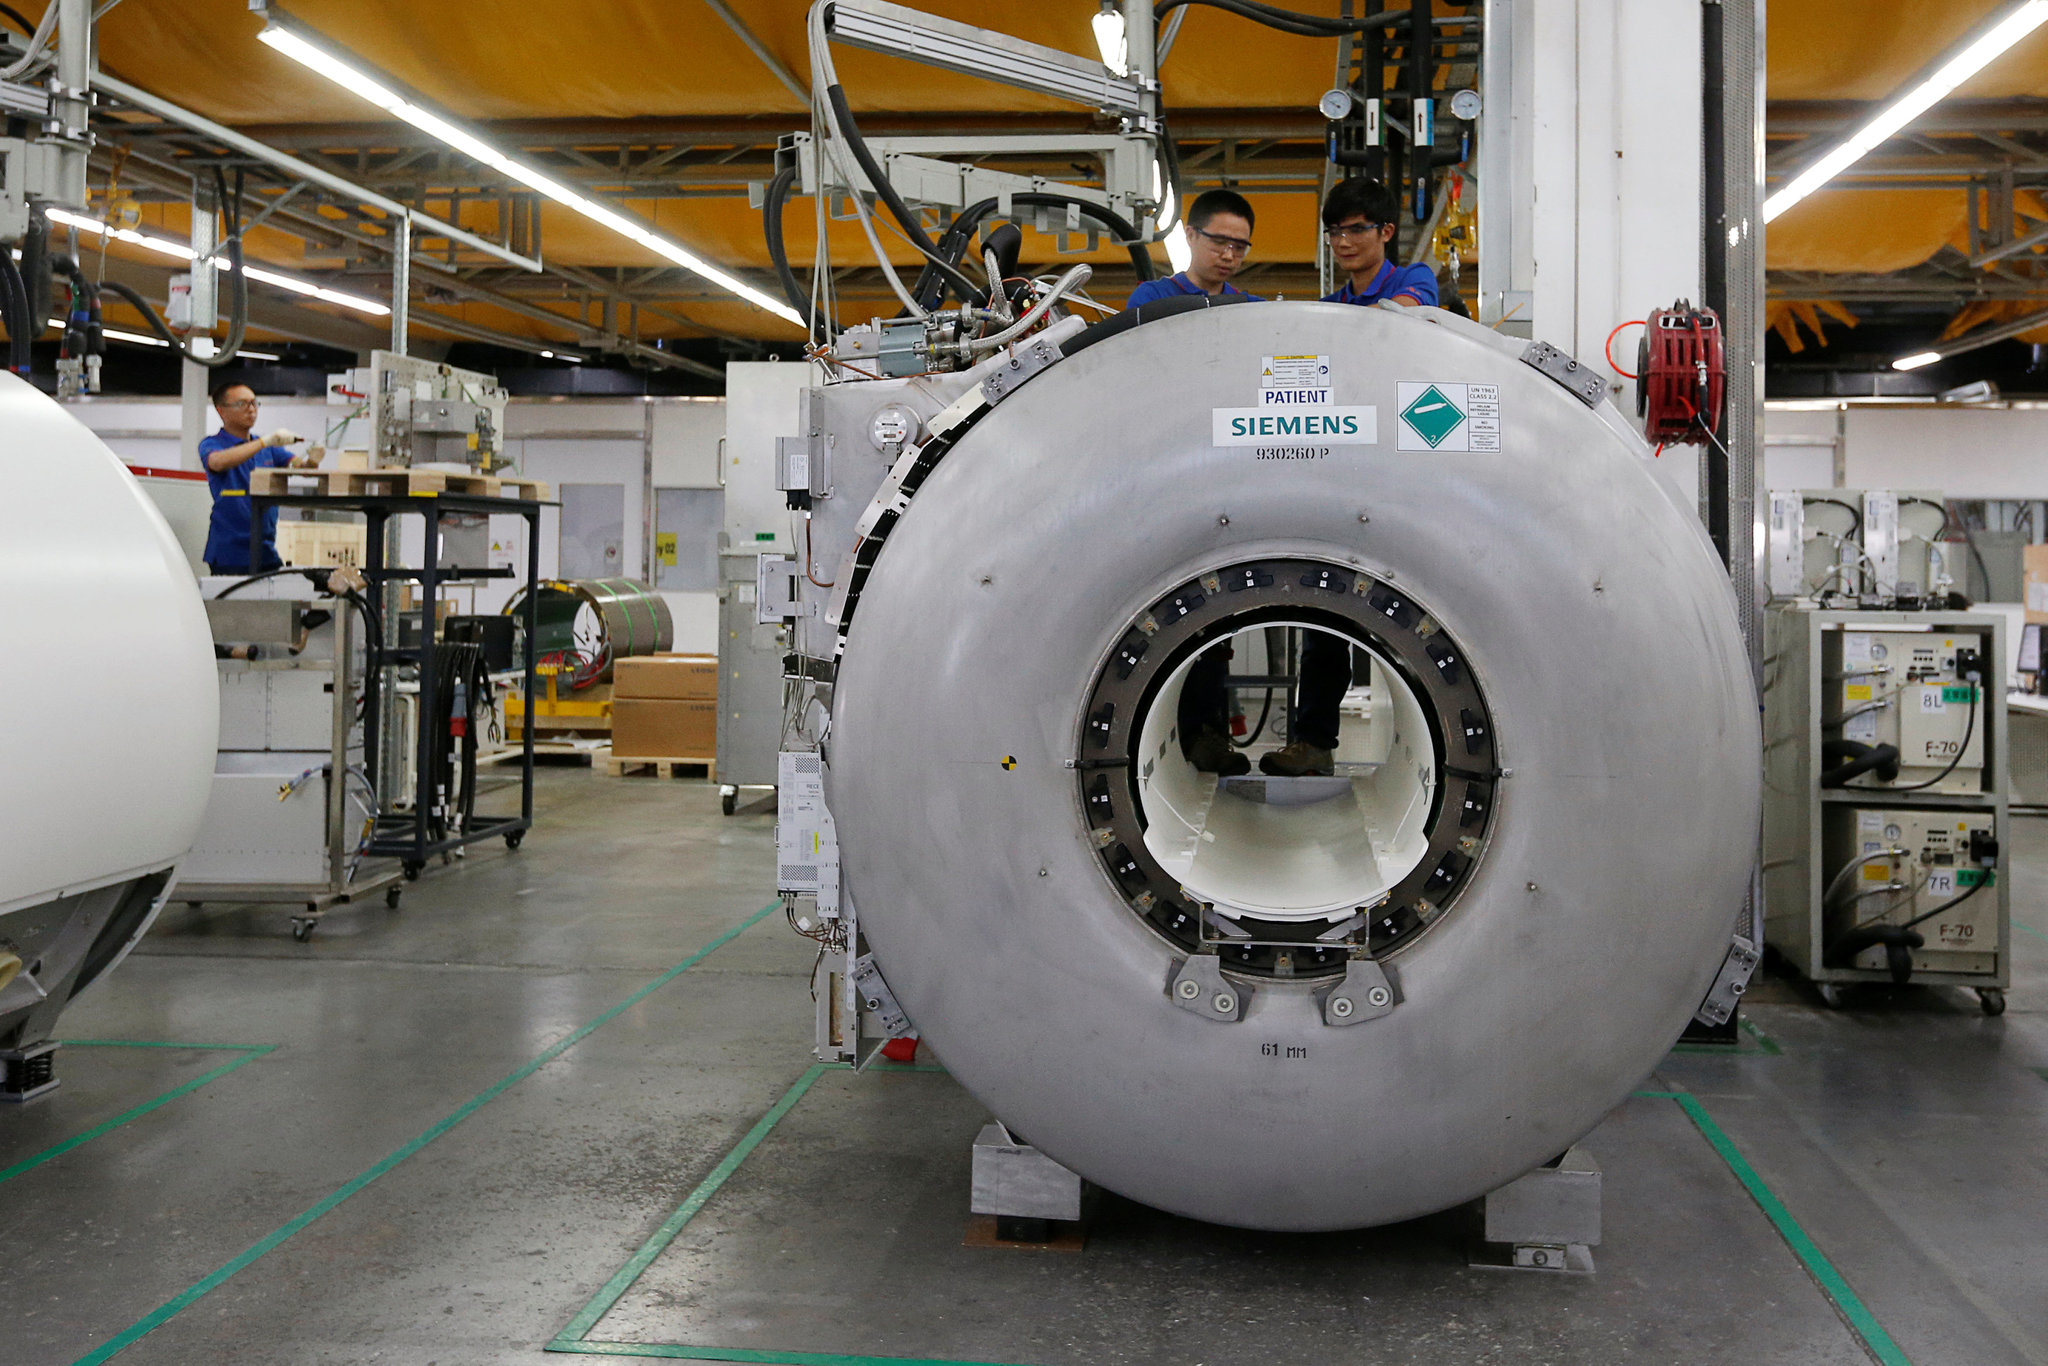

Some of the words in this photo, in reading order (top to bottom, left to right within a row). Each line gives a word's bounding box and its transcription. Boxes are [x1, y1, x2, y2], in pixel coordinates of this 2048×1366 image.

[1265, 390, 1328, 404] PATIENT
[1231, 416, 1358, 437] SIEMENS
[1430, 434, 1437, 443] 2
[1256, 447, 1316, 460] 930260
[1320, 447, 1330, 460] P
[665, 543, 675, 554] 02
[1923, 694, 1943, 708] 8L
[1926, 741, 1959, 753] F-70
[1929, 876, 1950, 891] 7R
[1940, 924, 1975, 937] F-70
[1261, 1043, 1278, 1056] 61
[1287, 1046, 1307, 1059] MM
